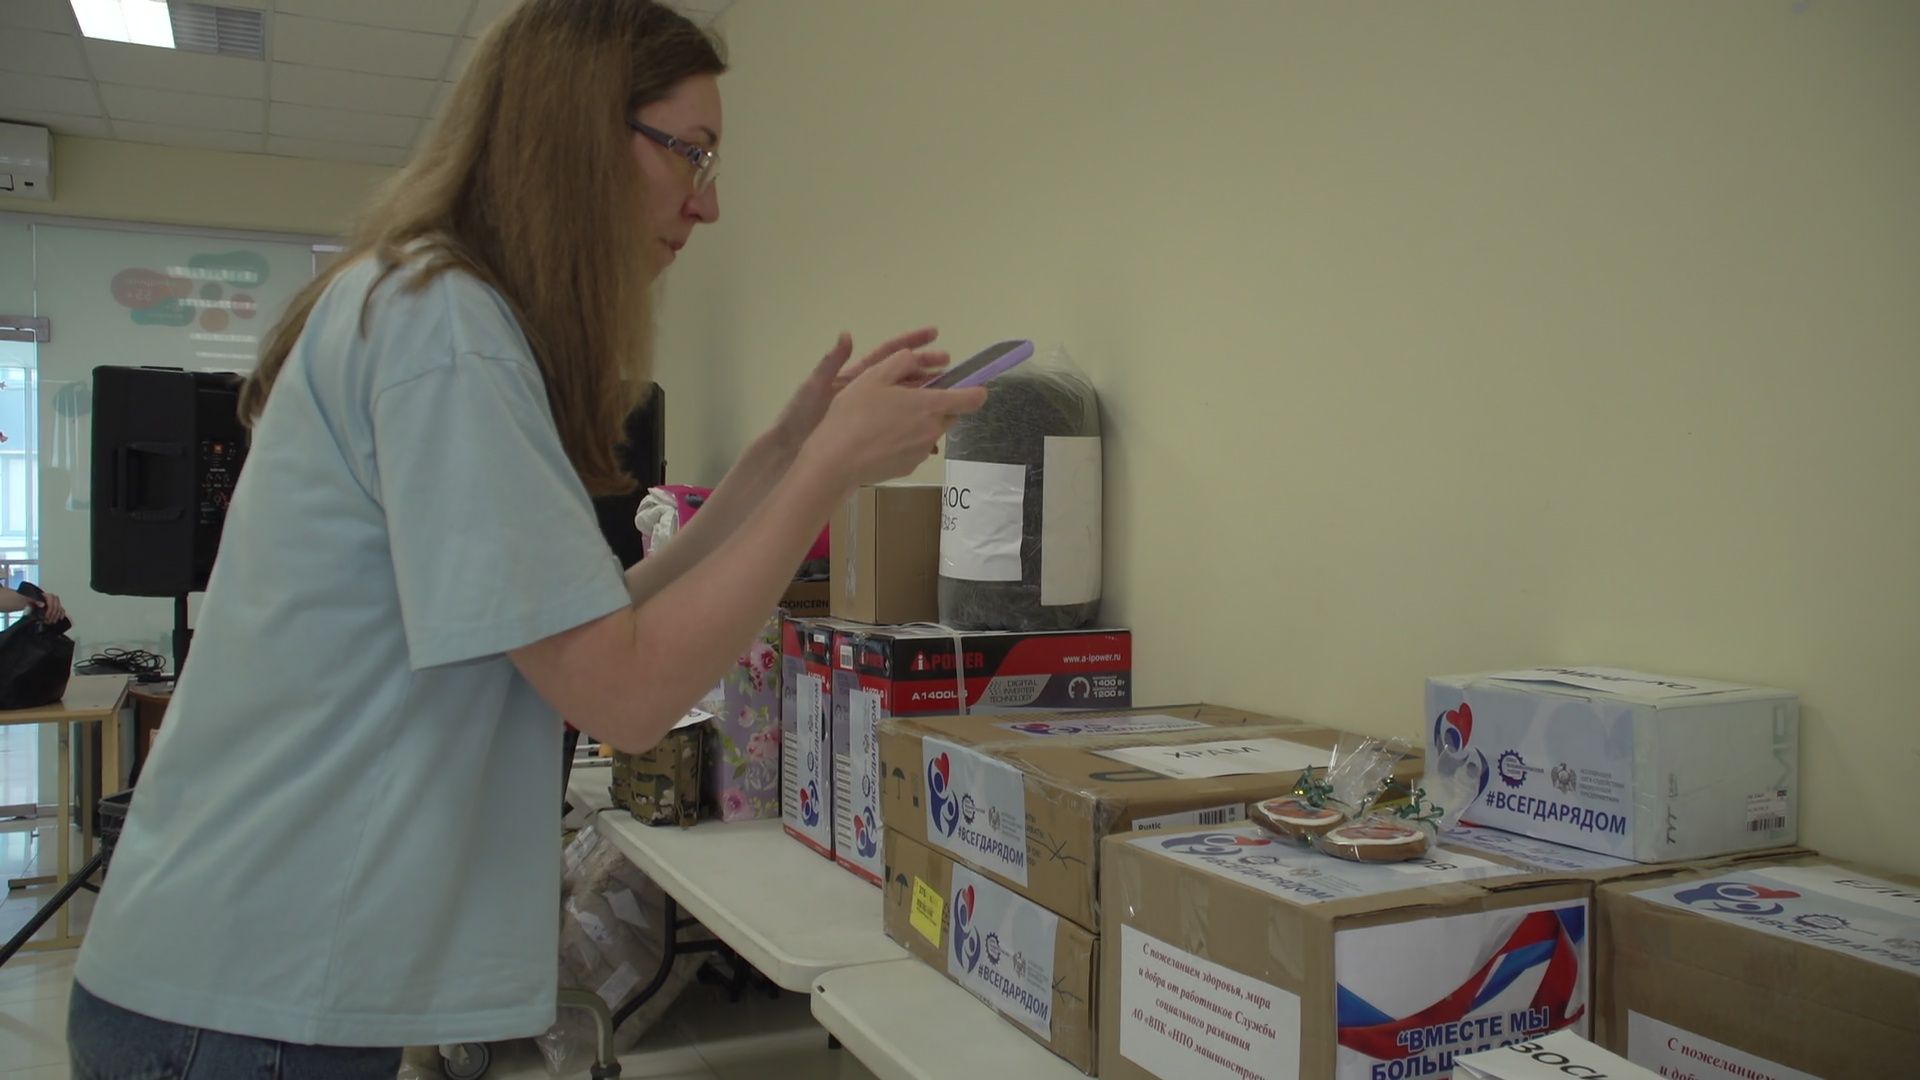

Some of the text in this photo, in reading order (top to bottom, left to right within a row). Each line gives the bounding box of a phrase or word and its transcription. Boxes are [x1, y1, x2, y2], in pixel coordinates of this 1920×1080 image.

[1486, 790, 1626, 836] #ВСЕГДАРЯДОМ
[957, 827, 1025, 868] #ВСЕГДАРЯДОМ
[977, 963, 1049, 1021] #ВСЕГДАРЯДОМ
[1142, 942, 1272, 1010] С пожеланием здоровья, мира
[1138, 967, 1277, 1039] и добра от работников Службы
[1155, 997, 1251, 1052] социального развития
[1511, 1006, 1550, 1032] МЫ
[1131, 1007, 1144, 1021] АО
[1144, 1015, 1168, 1035] «ВПК
[1167, 1028, 1195, 1049] «НПО
[1667, 1037, 1679, 1051] С
[1659, 1064, 1669, 1076] и
